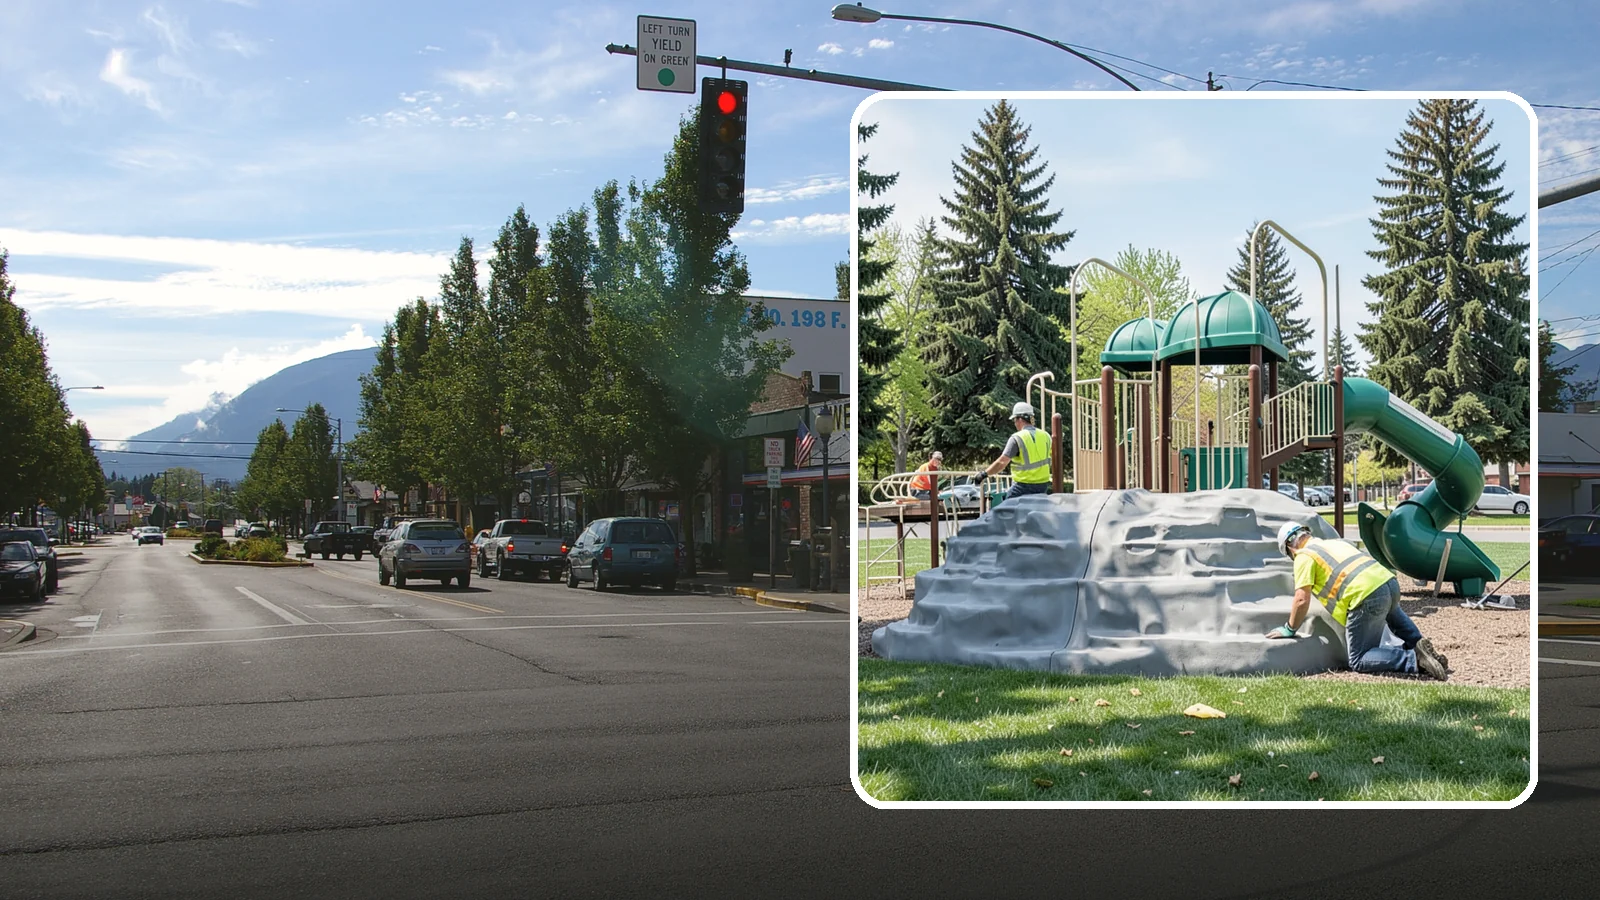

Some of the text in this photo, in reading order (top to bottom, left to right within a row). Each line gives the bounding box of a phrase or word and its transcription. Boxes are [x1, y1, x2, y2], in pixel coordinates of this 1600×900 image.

[643, 24, 690, 37] LEFT TURN
[652, 38, 682, 52] YIELD
[644, 53, 689, 66] ON GREEN
[791, 309, 826, 328] 198
[831, 311, 846, 329] F.
